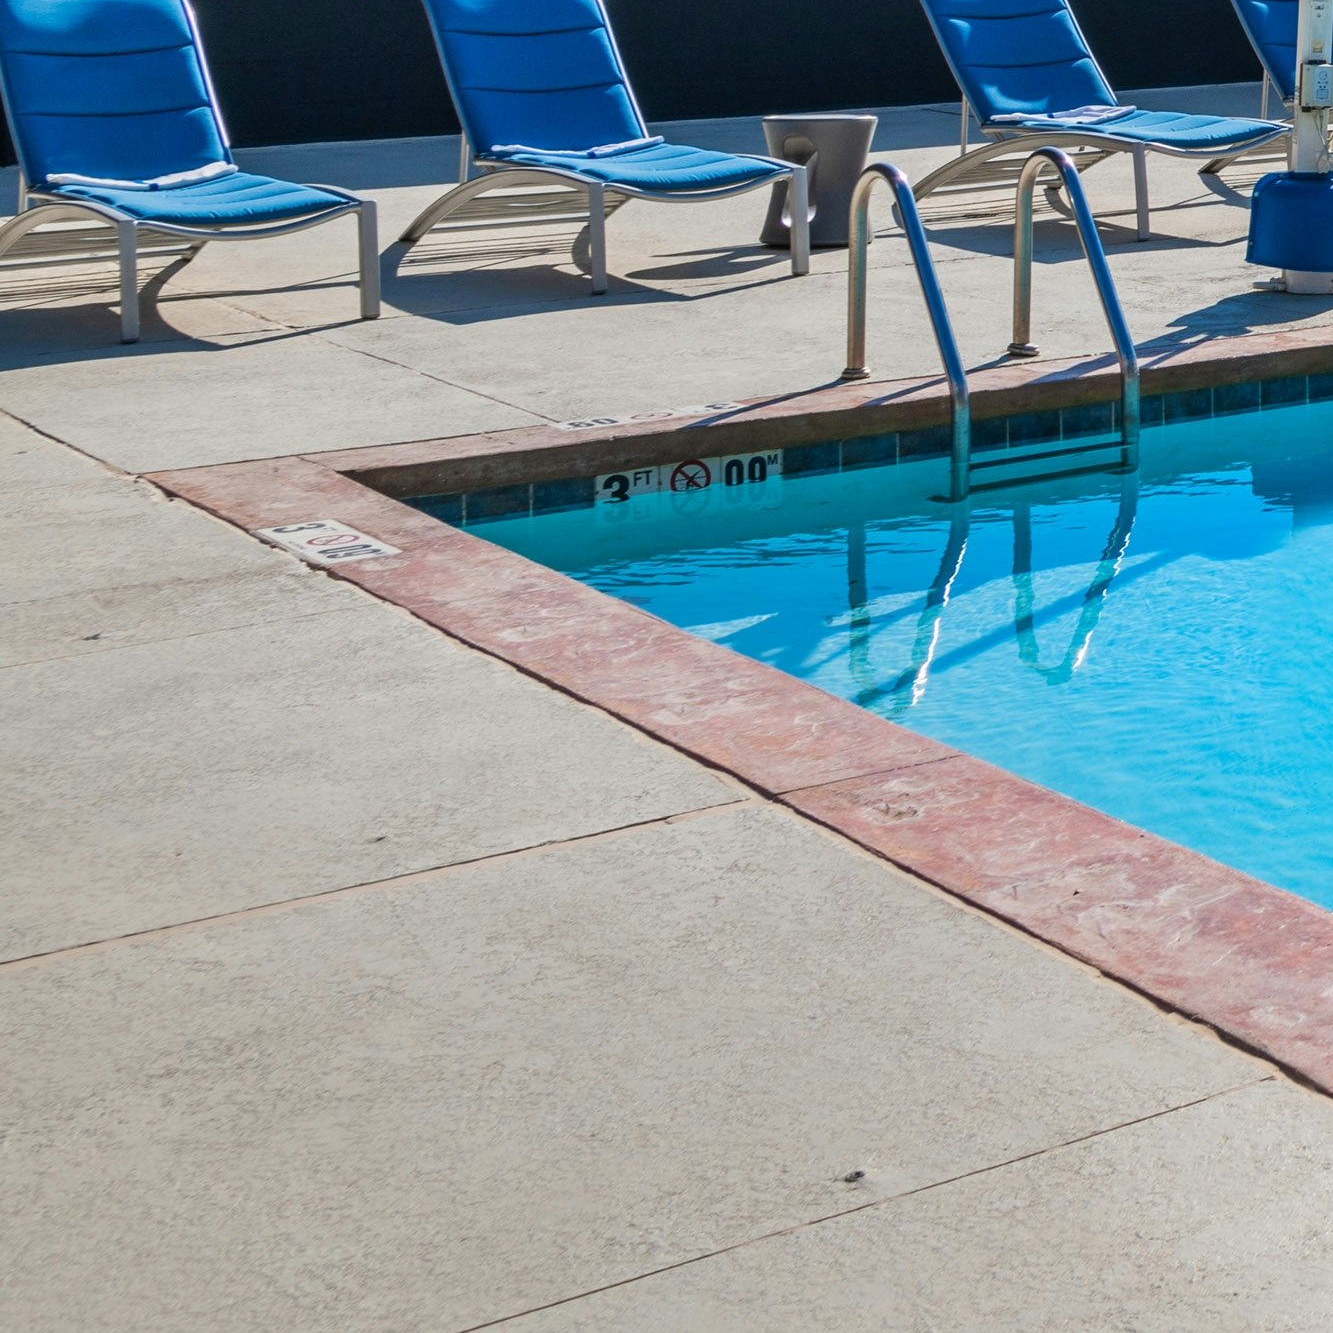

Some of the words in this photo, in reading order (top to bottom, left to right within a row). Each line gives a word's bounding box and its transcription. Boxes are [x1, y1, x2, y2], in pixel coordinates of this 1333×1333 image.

[603, 474, 630, 504] 3
[633, 469, 653, 487] FT
[767, 453, 779, 466] M
[272, 522, 327, 534] 3
